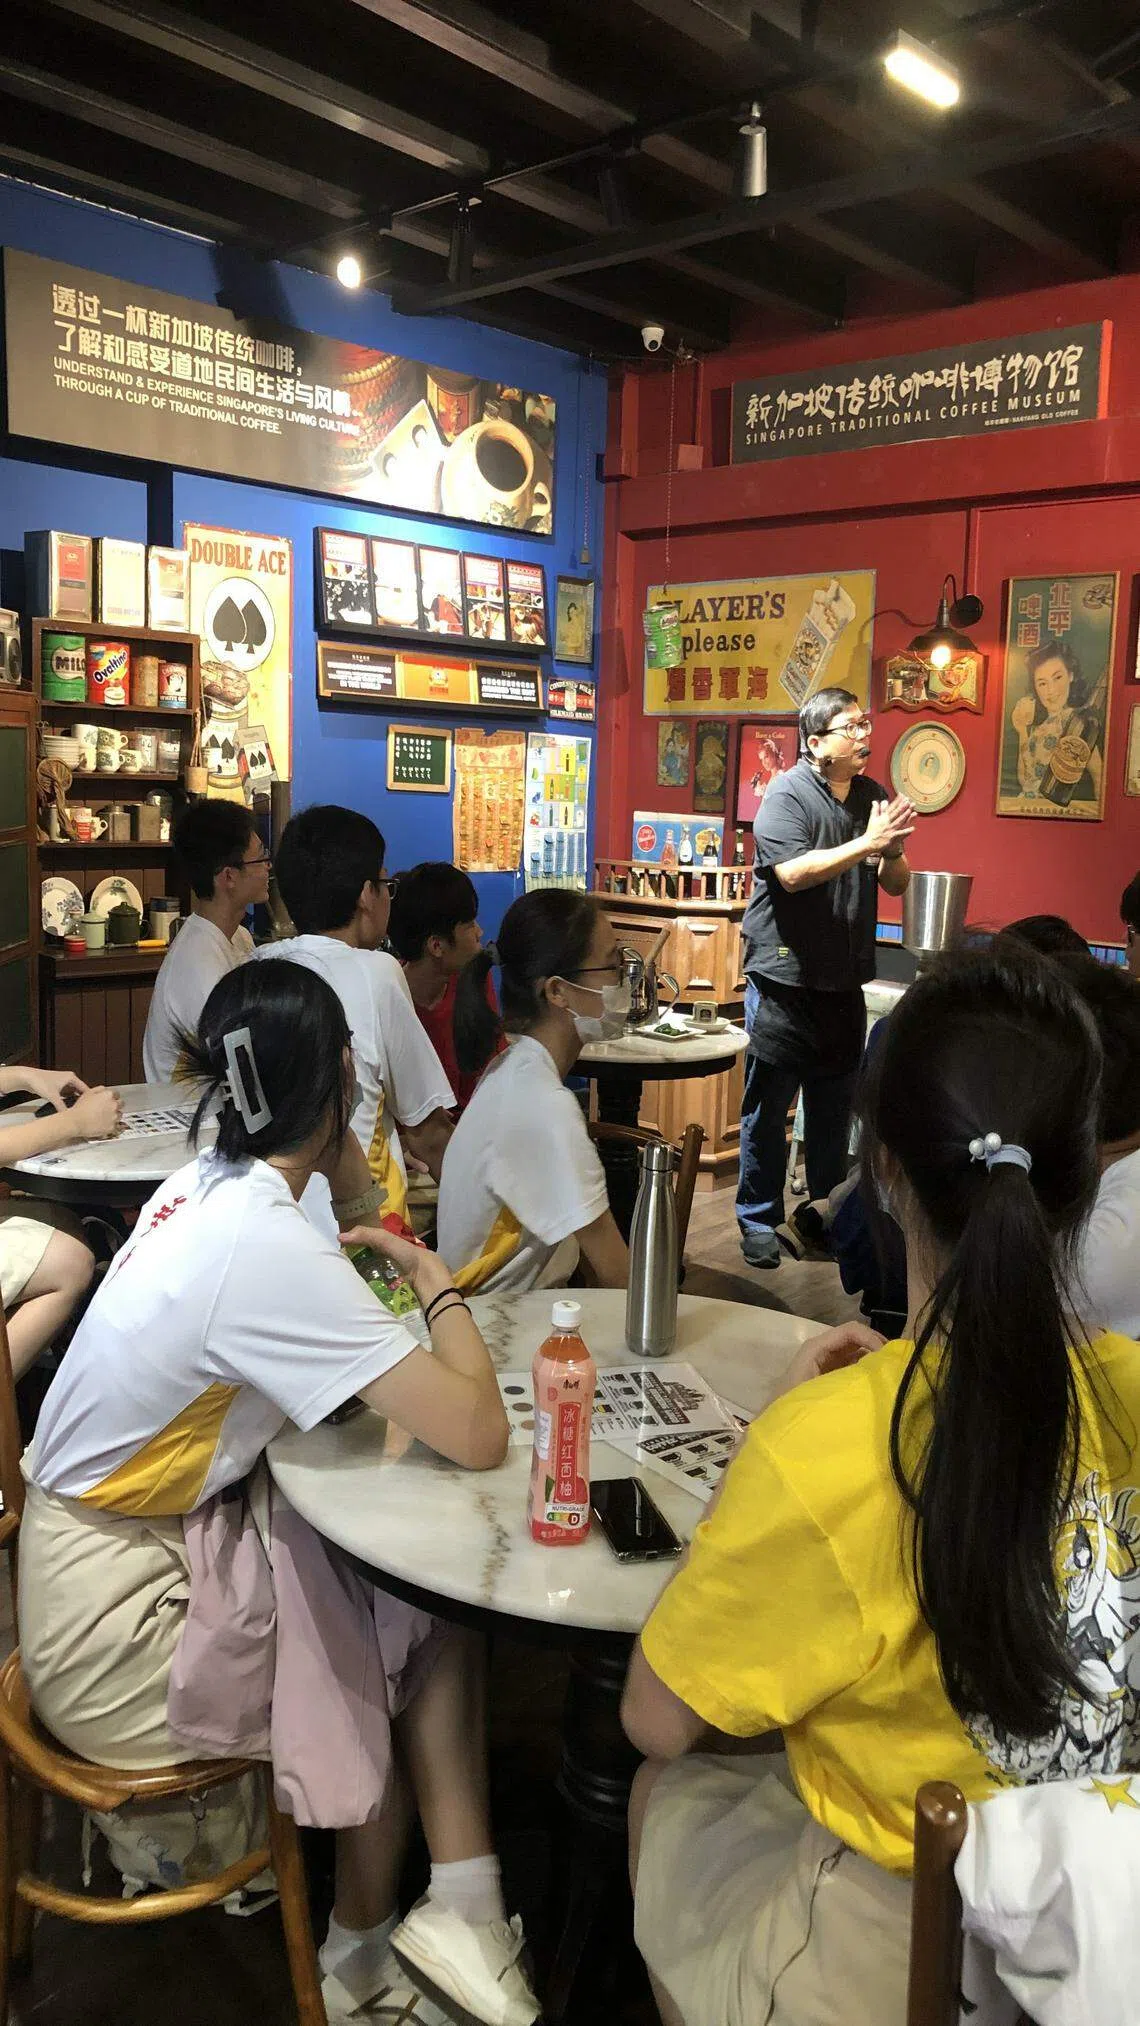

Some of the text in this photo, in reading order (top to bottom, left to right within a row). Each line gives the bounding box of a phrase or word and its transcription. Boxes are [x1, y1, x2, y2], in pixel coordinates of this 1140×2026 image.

[53, 357, 133, 386] UNDERSTAND
[136, 375, 145, 388] &
[147, 378, 213, 404] EXPERIENCE
[216, 395, 284, 419] SINGAPORE'S
[286, 410, 317, 427] LIVING
[54, 321, 363, 417] 了解和感受道地民间生活与风。
[54, 374, 282, 434] THROUGH A CUP OF TRADITIONAL COFFEE.
[746, 389, 1081, 445] SINGAPORE TRADITIONAL COFFEE MUSEUM
[190, 538, 287, 575] DOUBLE ACE
[656, 591, 786, 623] LAYER'S
[94, 651, 127, 683] Ovaltine
[681, 628, 756, 660] please
[560, 1408, 576, 1497] 冰糖红西柚
[571, 1514, 579, 1525] D
